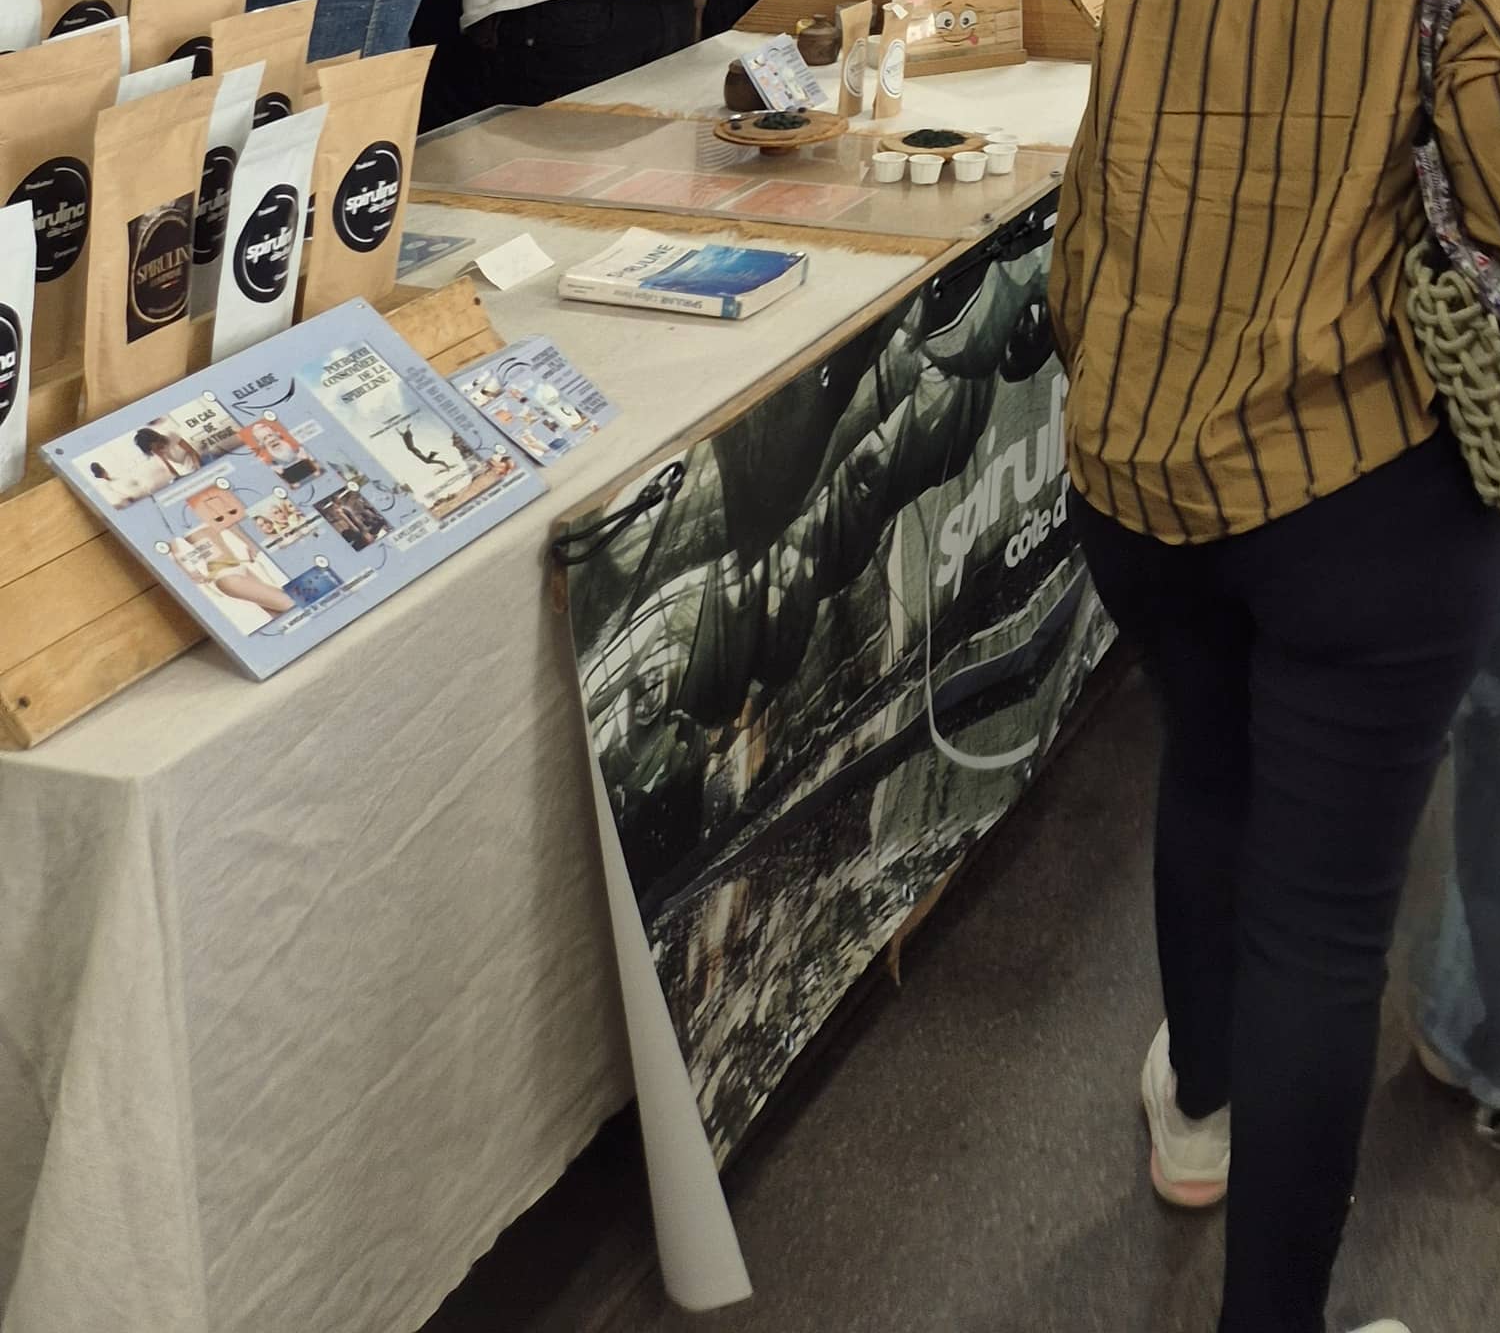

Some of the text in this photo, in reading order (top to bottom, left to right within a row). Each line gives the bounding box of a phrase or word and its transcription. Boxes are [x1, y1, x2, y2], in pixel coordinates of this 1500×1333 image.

[231, 372, 280, 400] ELLE AIDE
[184, 408, 217, 429] EN CAS
[1004, 507, 1051, 568] côte
